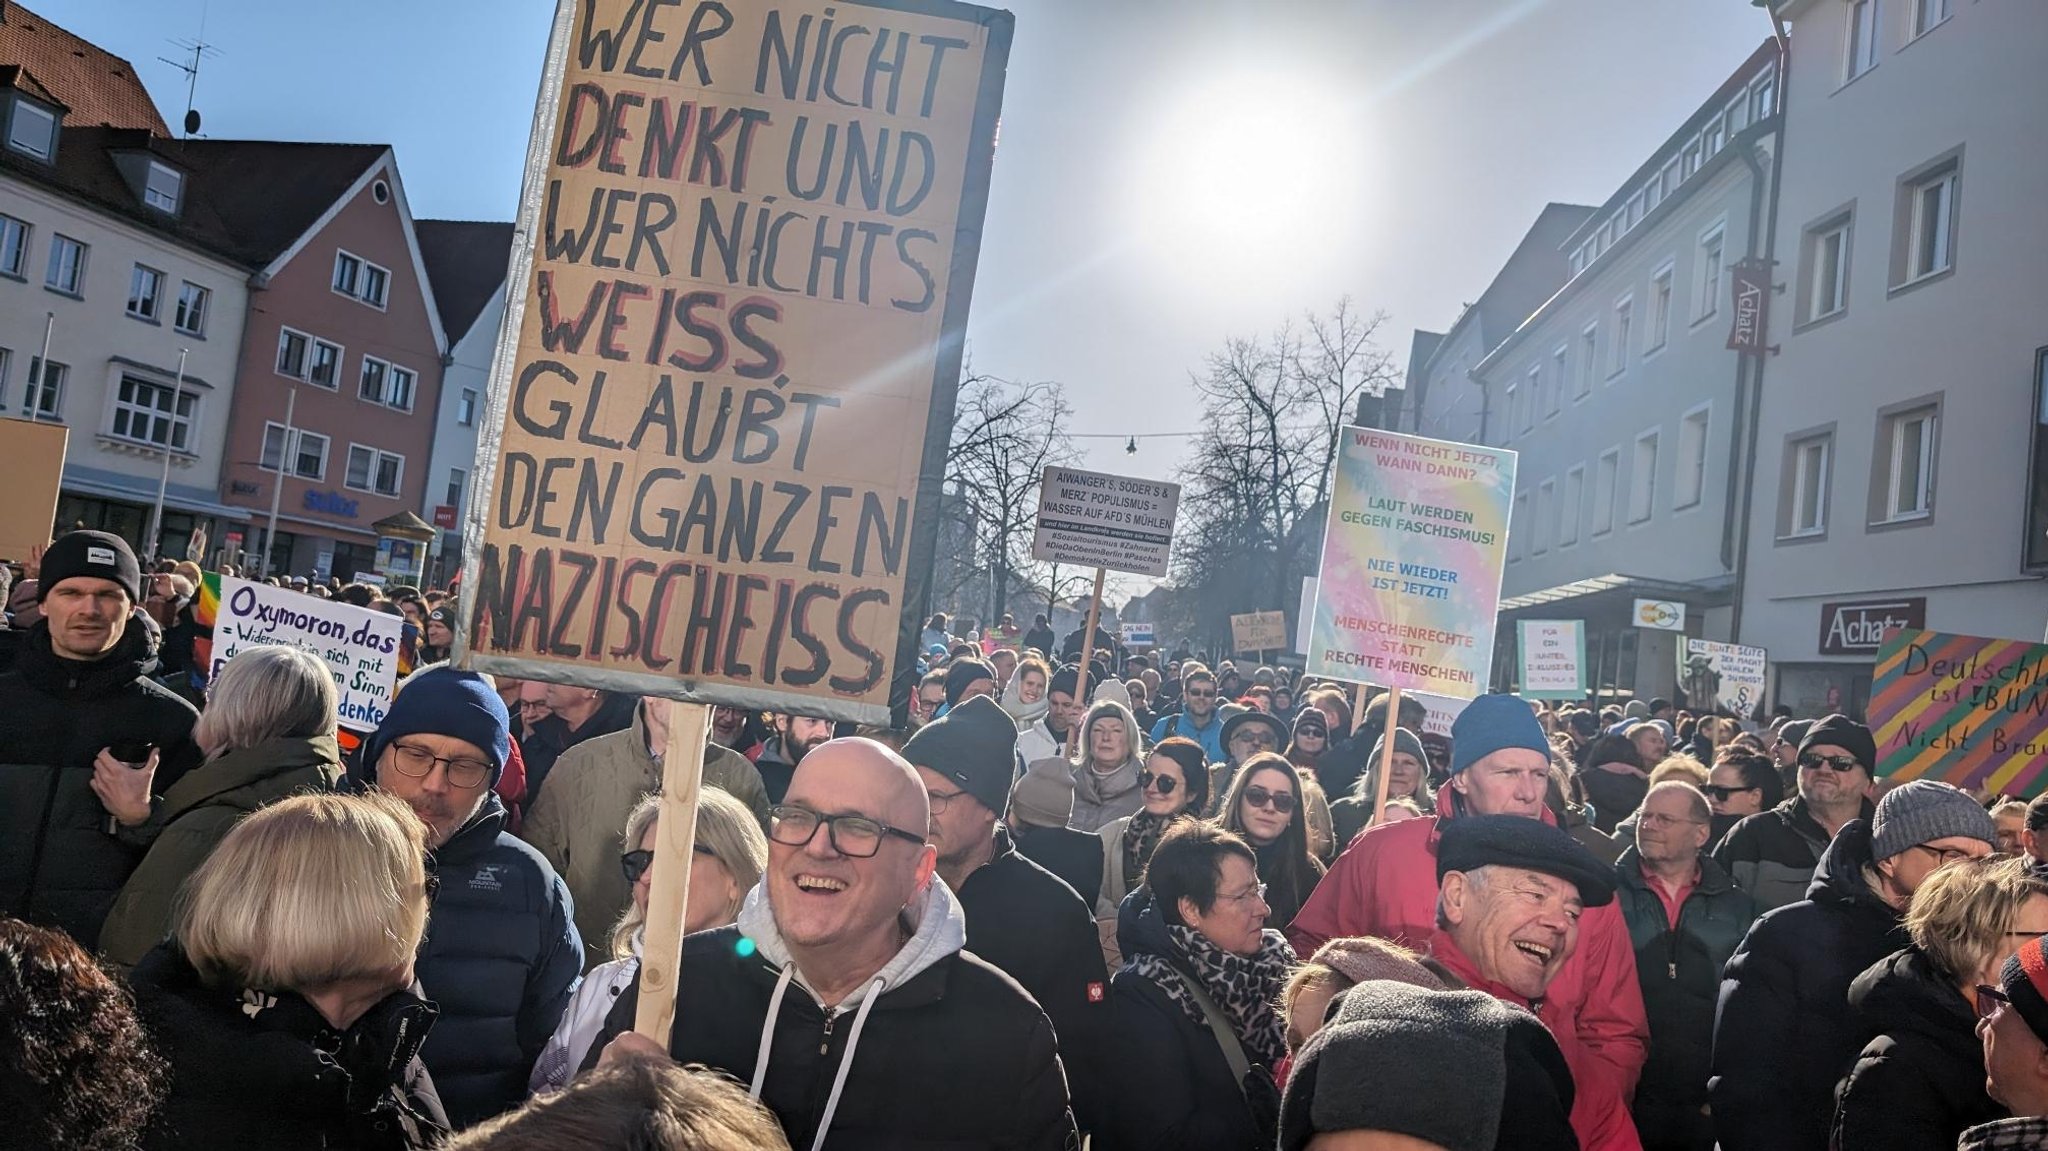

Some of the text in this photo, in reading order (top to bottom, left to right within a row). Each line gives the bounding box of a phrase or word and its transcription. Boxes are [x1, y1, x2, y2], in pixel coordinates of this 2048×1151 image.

[577, 0, 735, 86] WER
[556, 81, 936, 217] DENKT UND
[544, 180, 938, 313] WER NICHTS
[1735, 279, 1761, 345] Achatz
[513, 360, 841, 472] GLAUBT
[1354, 433, 1400, 452] WENN
[1404, 441, 1450, 461] NICHT
[1376, 453, 1477, 481] WANN DANN?
[1091, 493, 1150, 512] POPULISMUS
[1161, 487, 1169, 499] &
[499, 451, 909, 577] DEN GANZEN
[1044, 501, 1082, 517] WASSER
[1083, 507, 1102, 519] AUF
[1133, 513, 1172, 530] MÜHLEN
[1368, 496, 1474, 524] LAUT WERDEN
[1340, 510, 1495, 546] GEGEN FASCHISMUS!
[1119, 542, 1159, 554] #Zahnarzt
[1123, 552, 1162, 564] #Paschas
[1367, 557, 1458, 584] NIE WIEDER
[1372, 576, 1449, 600] IST JETZT!
[470, 543, 891, 697] NAZISCHEISS
[1334, 614, 1474, 648] MENSCHENRECHTE
[325, 648, 350, 666] sich
[358, 657, 383, 673] mit
[1380, 639, 1426, 658] STATT
[1325, 649, 1474, 684] RECHTE MENSCHEN!
[1903, 643, 2048, 686] Deutschl
[350, 670, 390, 701] Sinn,
[1931, 684, 1961, 704] ist
[1892, 721, 1973, 751] Nicht
